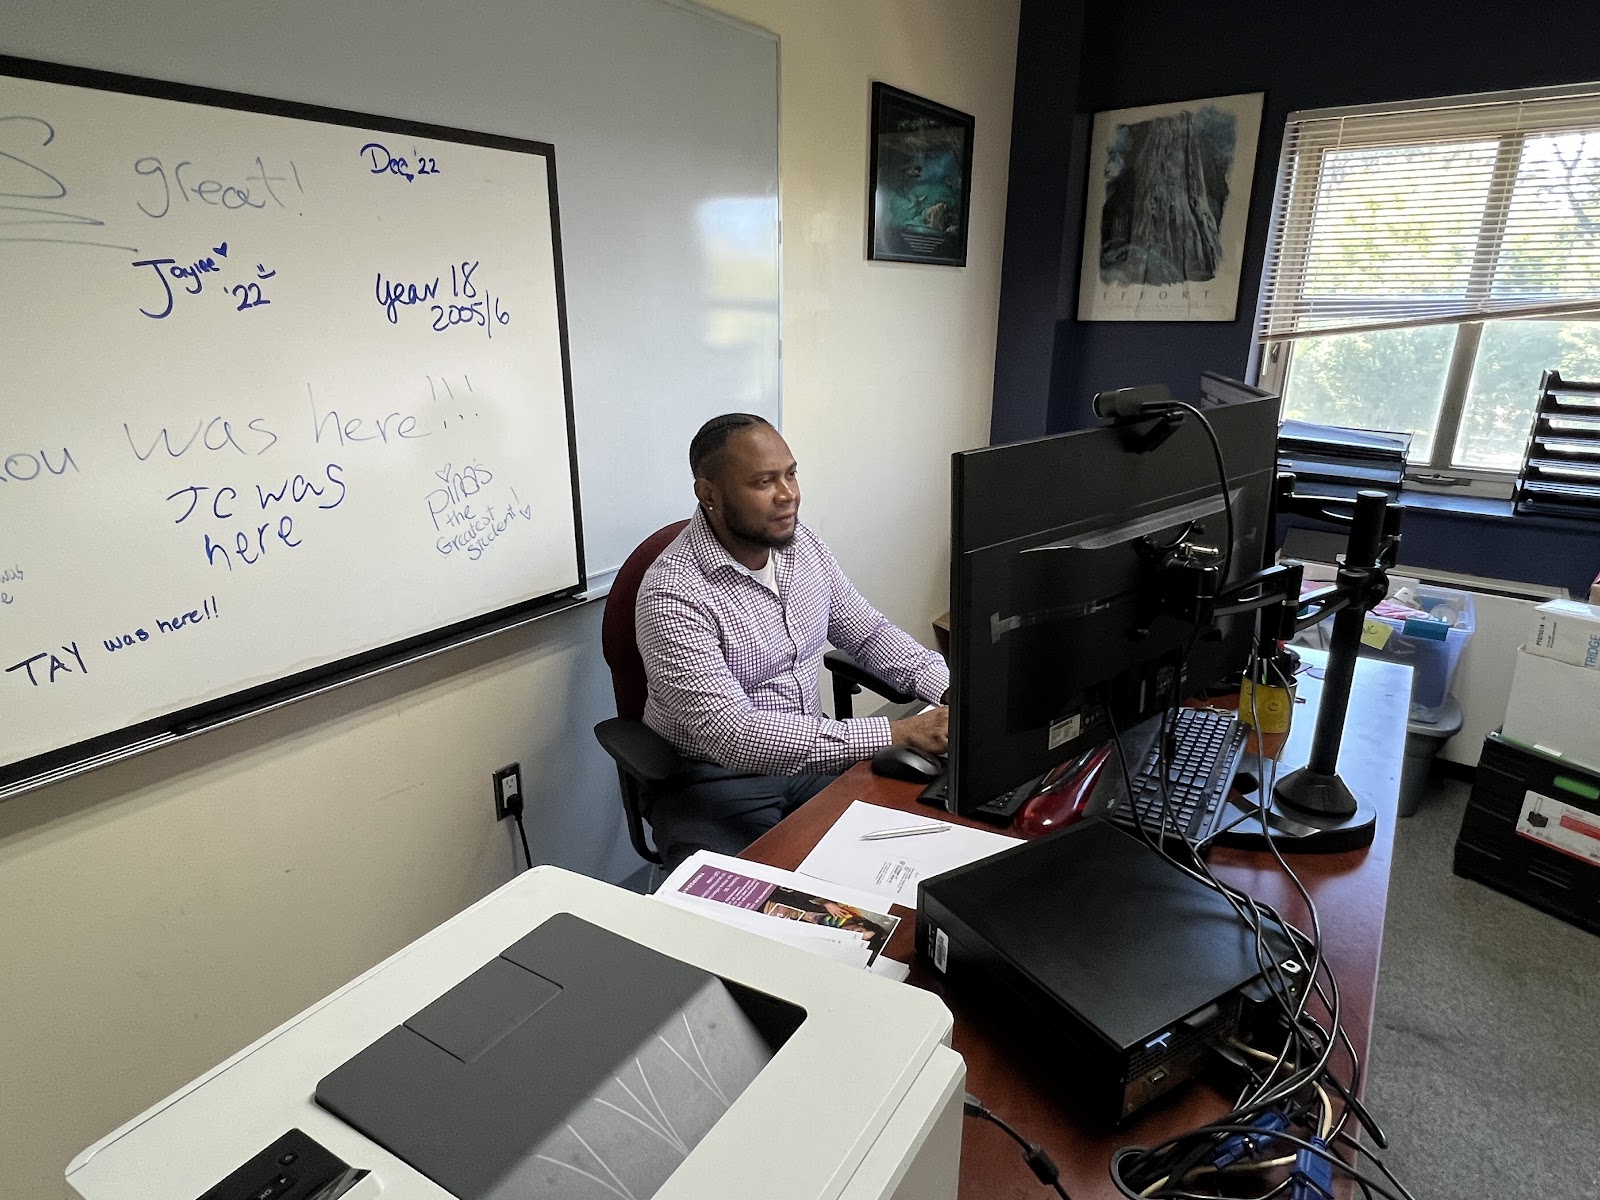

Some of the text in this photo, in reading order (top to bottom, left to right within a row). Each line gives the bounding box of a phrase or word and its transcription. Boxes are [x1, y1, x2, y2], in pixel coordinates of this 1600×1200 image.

[360, 143, 409, 178] Dec
[134, 156, 305, 218] great!
[451, 261, 480, 298] 18
[1103, 290, 1210, 301] EFFORT
[430, 289, 511, 340] 2005/6
[123, 415, 278, 461] was
[255, 463, 346, 510] was
[446, 505, 477, 527] the
[204, 515, 303, 572] here
[5, 595, 219, 686] TAY was here!!
